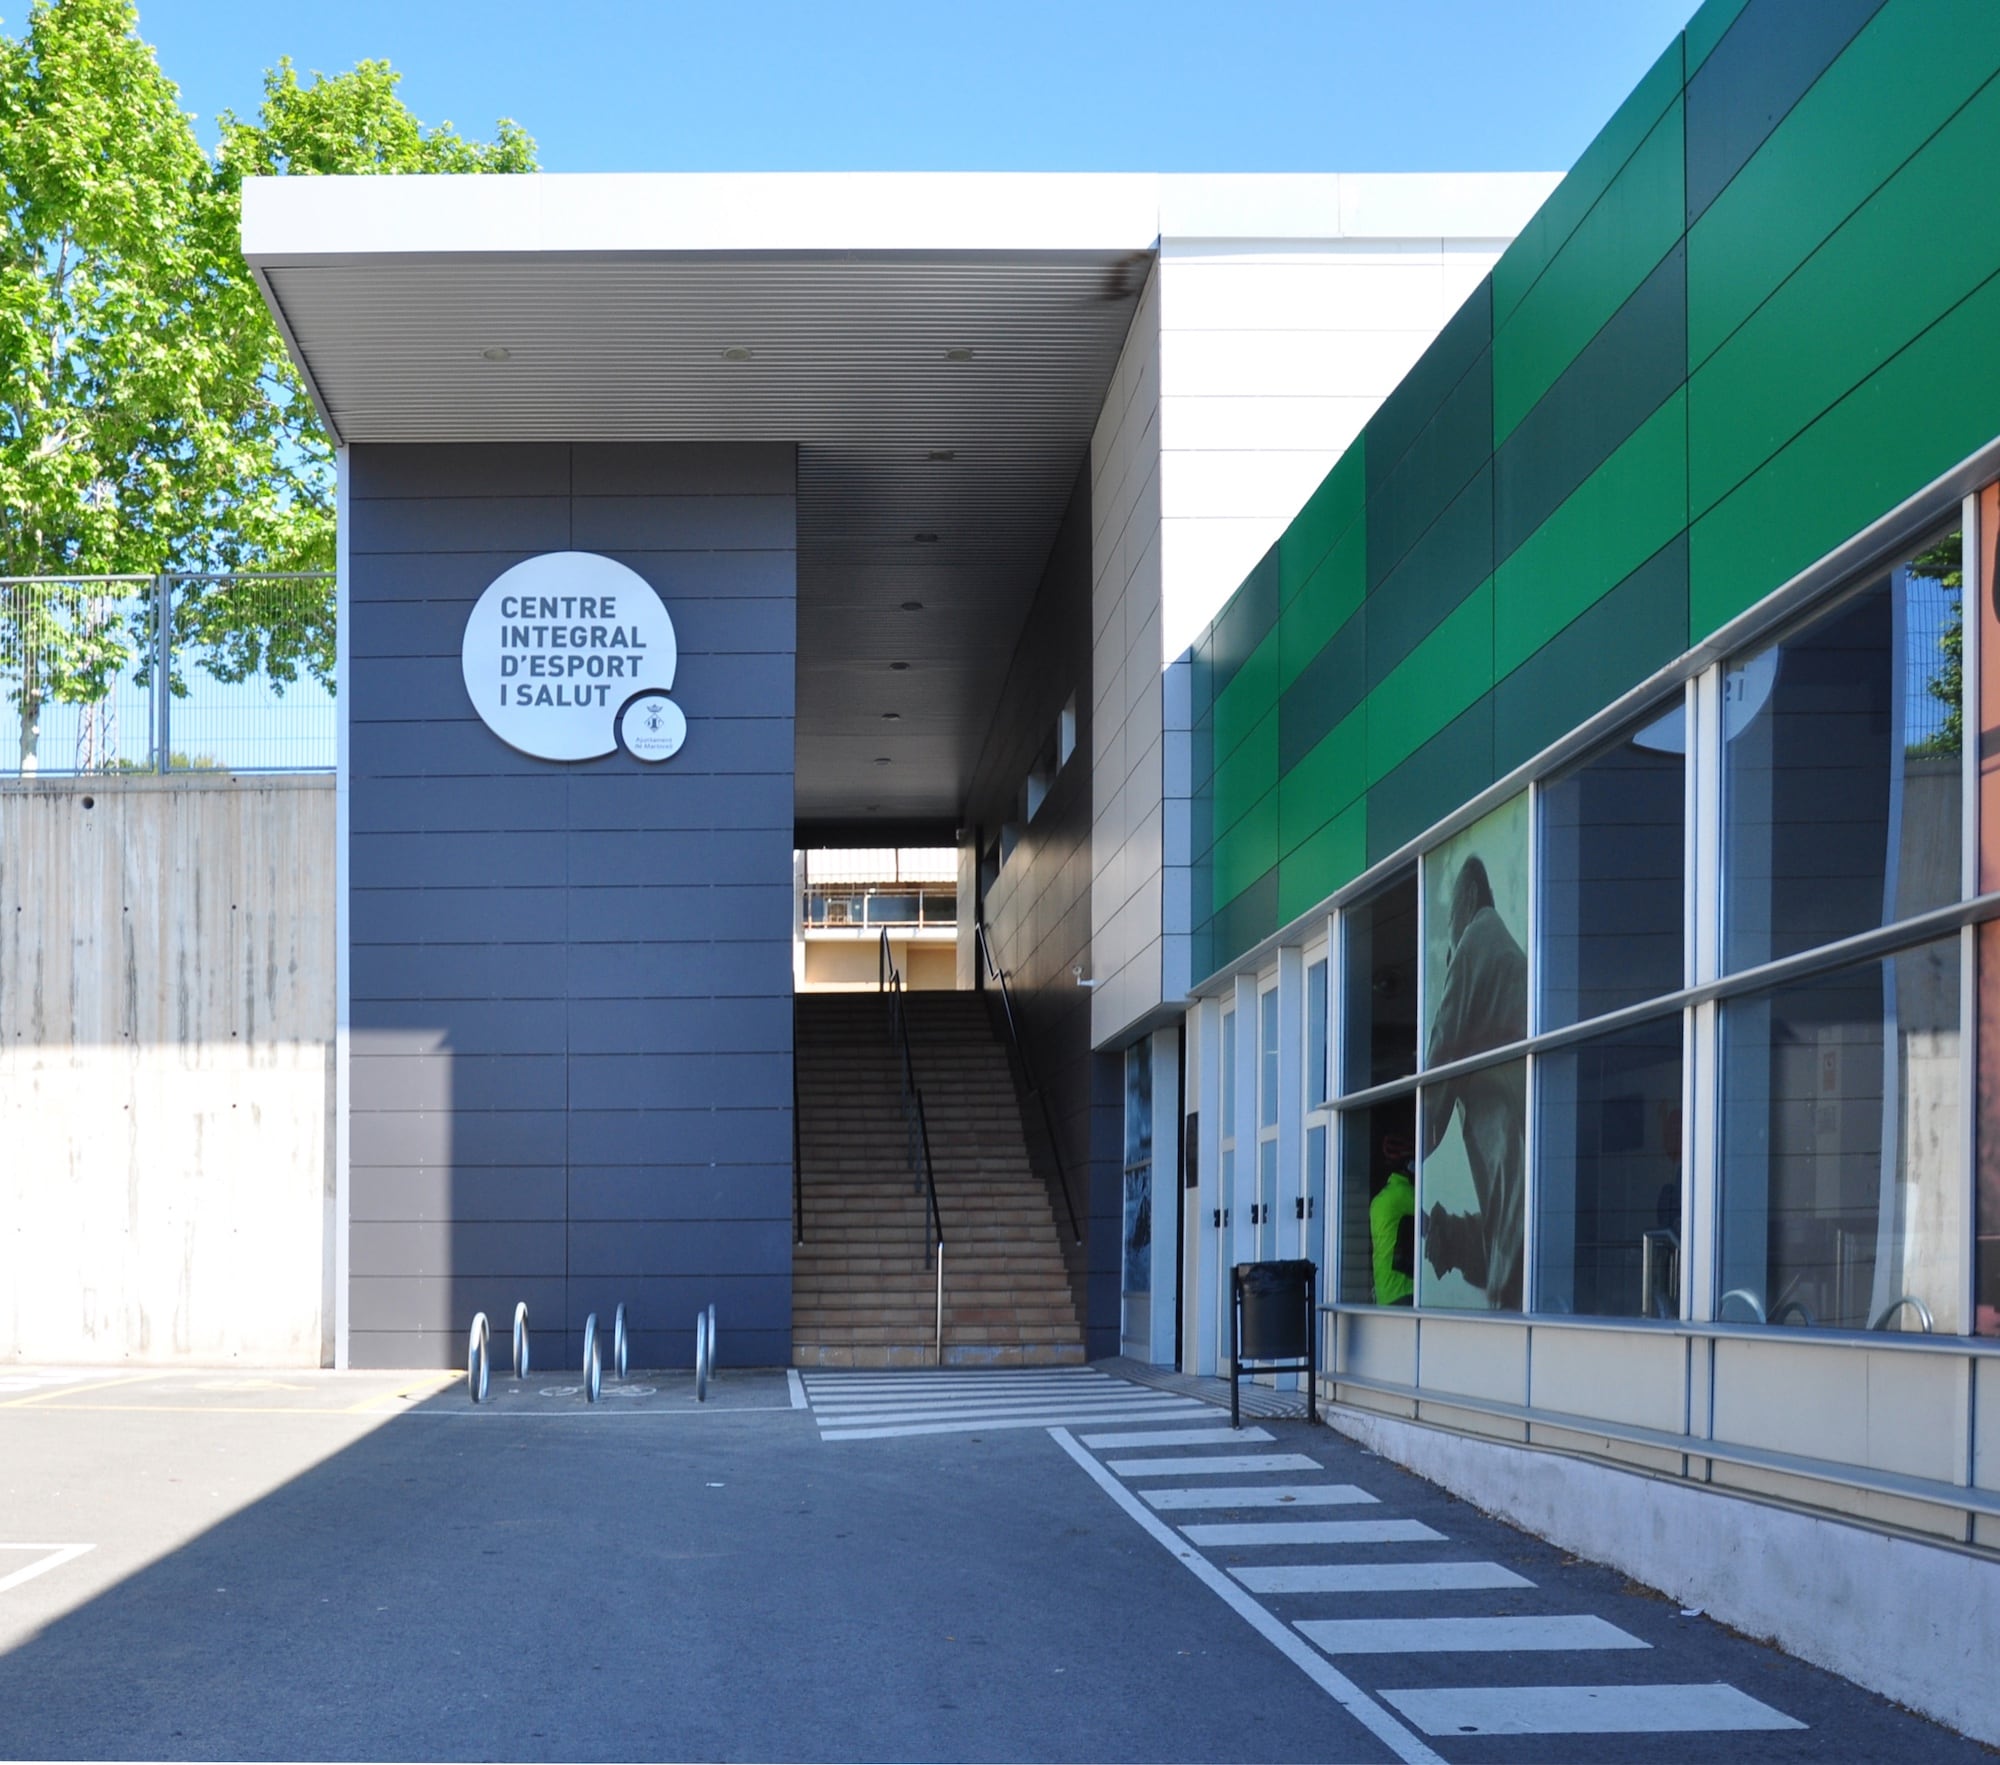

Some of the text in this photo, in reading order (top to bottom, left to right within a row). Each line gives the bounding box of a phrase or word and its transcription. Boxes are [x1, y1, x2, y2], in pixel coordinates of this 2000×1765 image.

[501, 596, 616, 618] CENTRE
[501, 626, 647, 648] INTEGRAL
[501, 655, 643, 677] D'ESPORT
[501, 684, 611, 706] I SALUT
